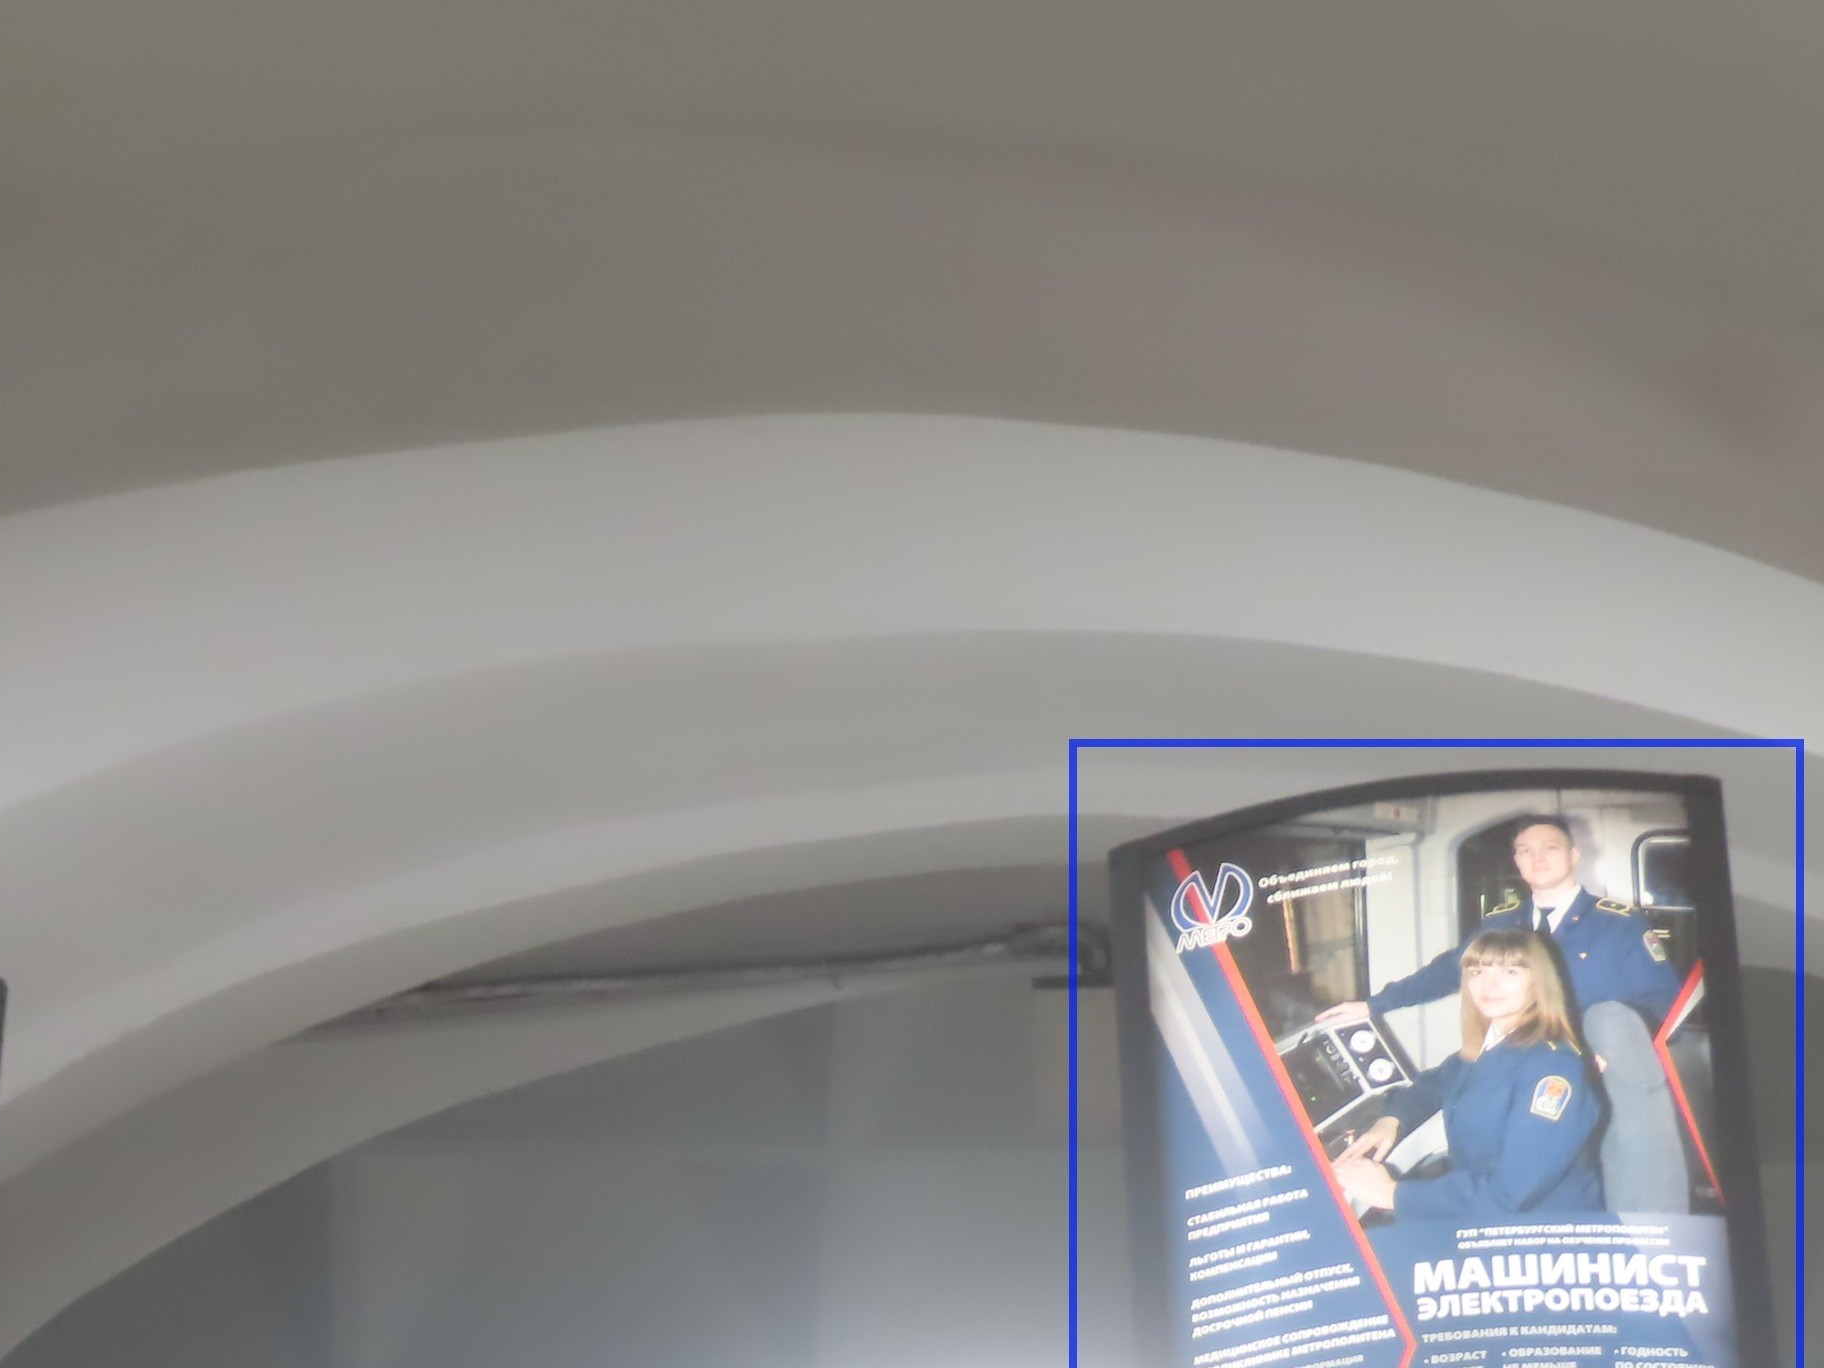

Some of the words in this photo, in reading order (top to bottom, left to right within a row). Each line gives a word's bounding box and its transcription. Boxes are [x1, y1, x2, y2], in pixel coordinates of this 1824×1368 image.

[1258, 863, 1350, 888] Объединяем
[1352, 856, 1399, 869] город,
[1267, 882, 1339, 904] сближаем
[1340, 871, 1392, 890] людей!
[1176, 917, 1252, 953] МЕТРО
[1185, 1165, 1292, 1200] ПРЕИМУЩЕСТВА:
[1187, 1199, 1261, 1226] СТАБИЛЬНАЯ
[1262, 1189, 1308, 1208] РАБОТА
[1188, 1212, 1270, 1241] ПРЕДПРИЯТИЯ
[1457, 1229, 1478, 1238] ГУП
[1189, 1247, 1234, 1267] ЛЬГОТЫ
[1236, 1244, 1245, 1255] И
[1246, 1230, 1311, 1252] ГАРАНТИИ,
[1458, 1238, 1513, 1249] ОБЪЯВЛЯЕТ
[1514, 1237, 1547, 1246] НАБОР
[1547, 1237, 1561, 1245] НА
[1562, 1237, 1611, 1245] ОБУЧЕНИЕ
[1190, 1251, 1278, 1280] КОМПЕНСАЦИИ
[1414, 1253, 1706, 1294] МАШИНИСТ
[1191, 1272, 1303, 1310] ДОПОЛНИТЕЛЬНЫЙ
[1305, 1263, 1354, 1280] ОТПУСК,
[1192, 1294, 1280, 1323] ВОЗМОЖНОСТЬ
[1281, 1277, 1360, 1300] НАЗНАЧЕНИЯ
[1192, 1310, 1264, 1339] ДОСРОЧНОЙ
[1265, 1300, 1313, 1318] ПЕНСИИ
[1417, 1288, 1708, 1320] ЭЛЕКТРОПОЕЗДА
[1194, 1336, 1281, 1365] МЕДИЦИНСКОЕ
[1282, 1315, 1389, 1345] СОПРОВОЖДЕНИЕ
[1291, 1329, 1395, 1357] МЕТРОПОЛИТЕНА
[1422, 1327, 1508, 1343] ТРЕБОВАНИЯ
[1509, 1327, 1519, 1336] К
[1520, 1325, 1617, 1335] КАНДИДАТАМ:
[1431, 1350, 1487, 1364] ВОЗРАСТ
[1508, 1346, 1602, 1357] ОБРАЗОВАНИЕ
[1621, 1347, 1688, 1358] ГОДНОСТЬ
